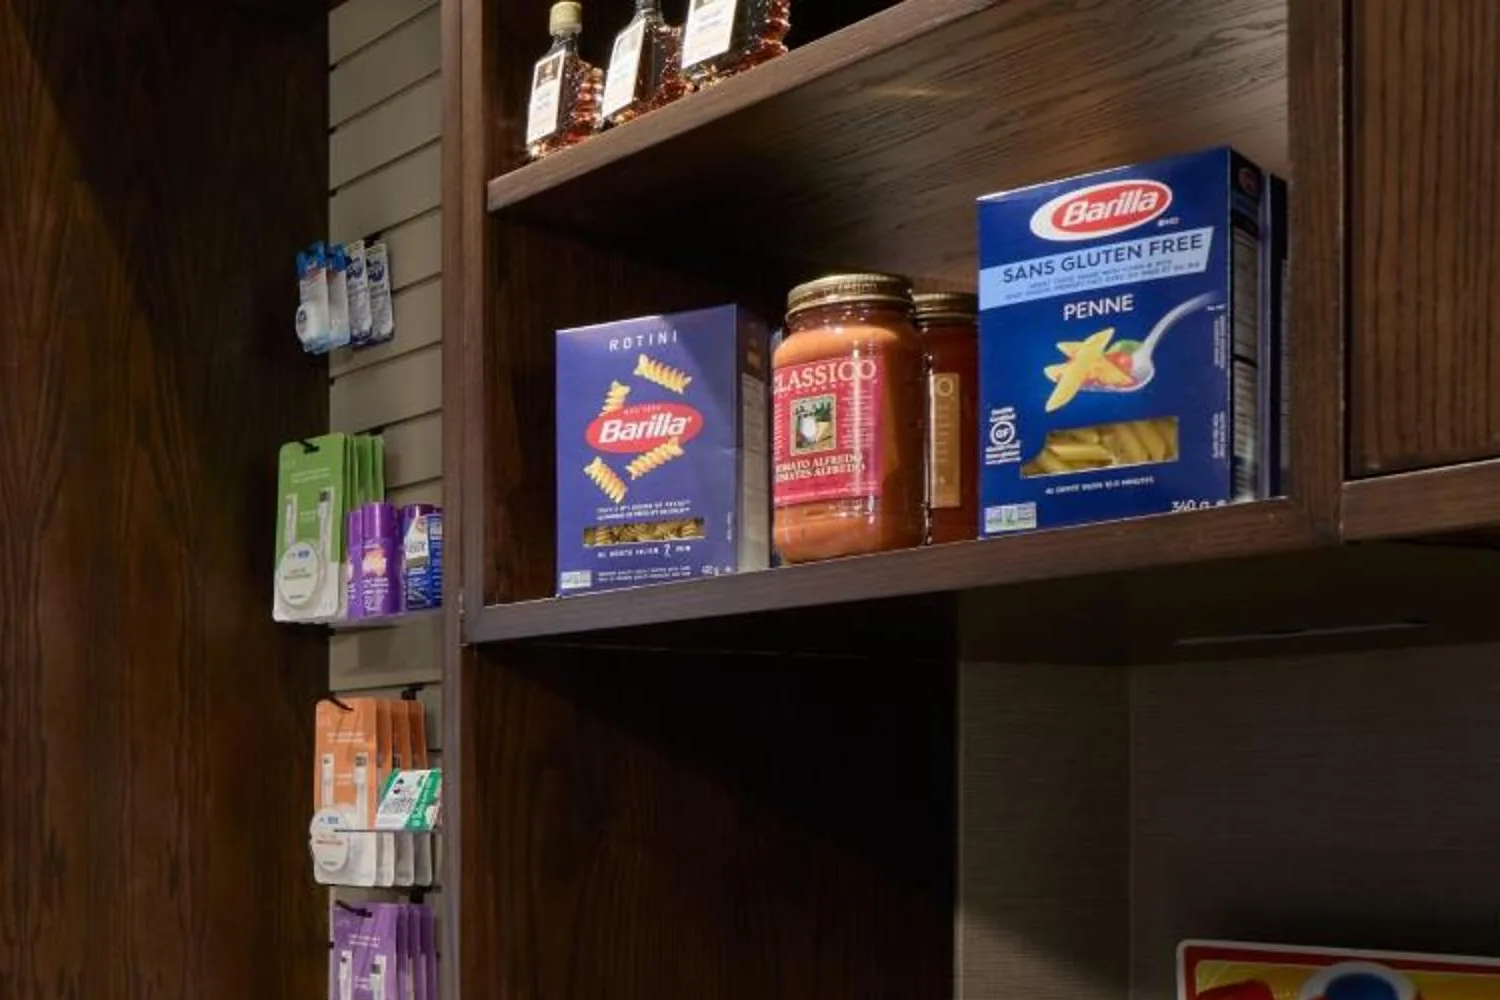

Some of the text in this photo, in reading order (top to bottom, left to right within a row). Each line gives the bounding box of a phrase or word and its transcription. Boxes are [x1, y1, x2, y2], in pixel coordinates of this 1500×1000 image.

[1061, 188, 1159, 227] Barilla
[1003, 260, 1055, 284] SANS
[1061, 243, 1143, 273] GLUTEN
[1149, 233, 1204, 257] FREE
[1063, 293, 1135, 321] PENNE
[609, 330, 678, 353] ROTINI
[599, 411, 687, 443] Barilla
